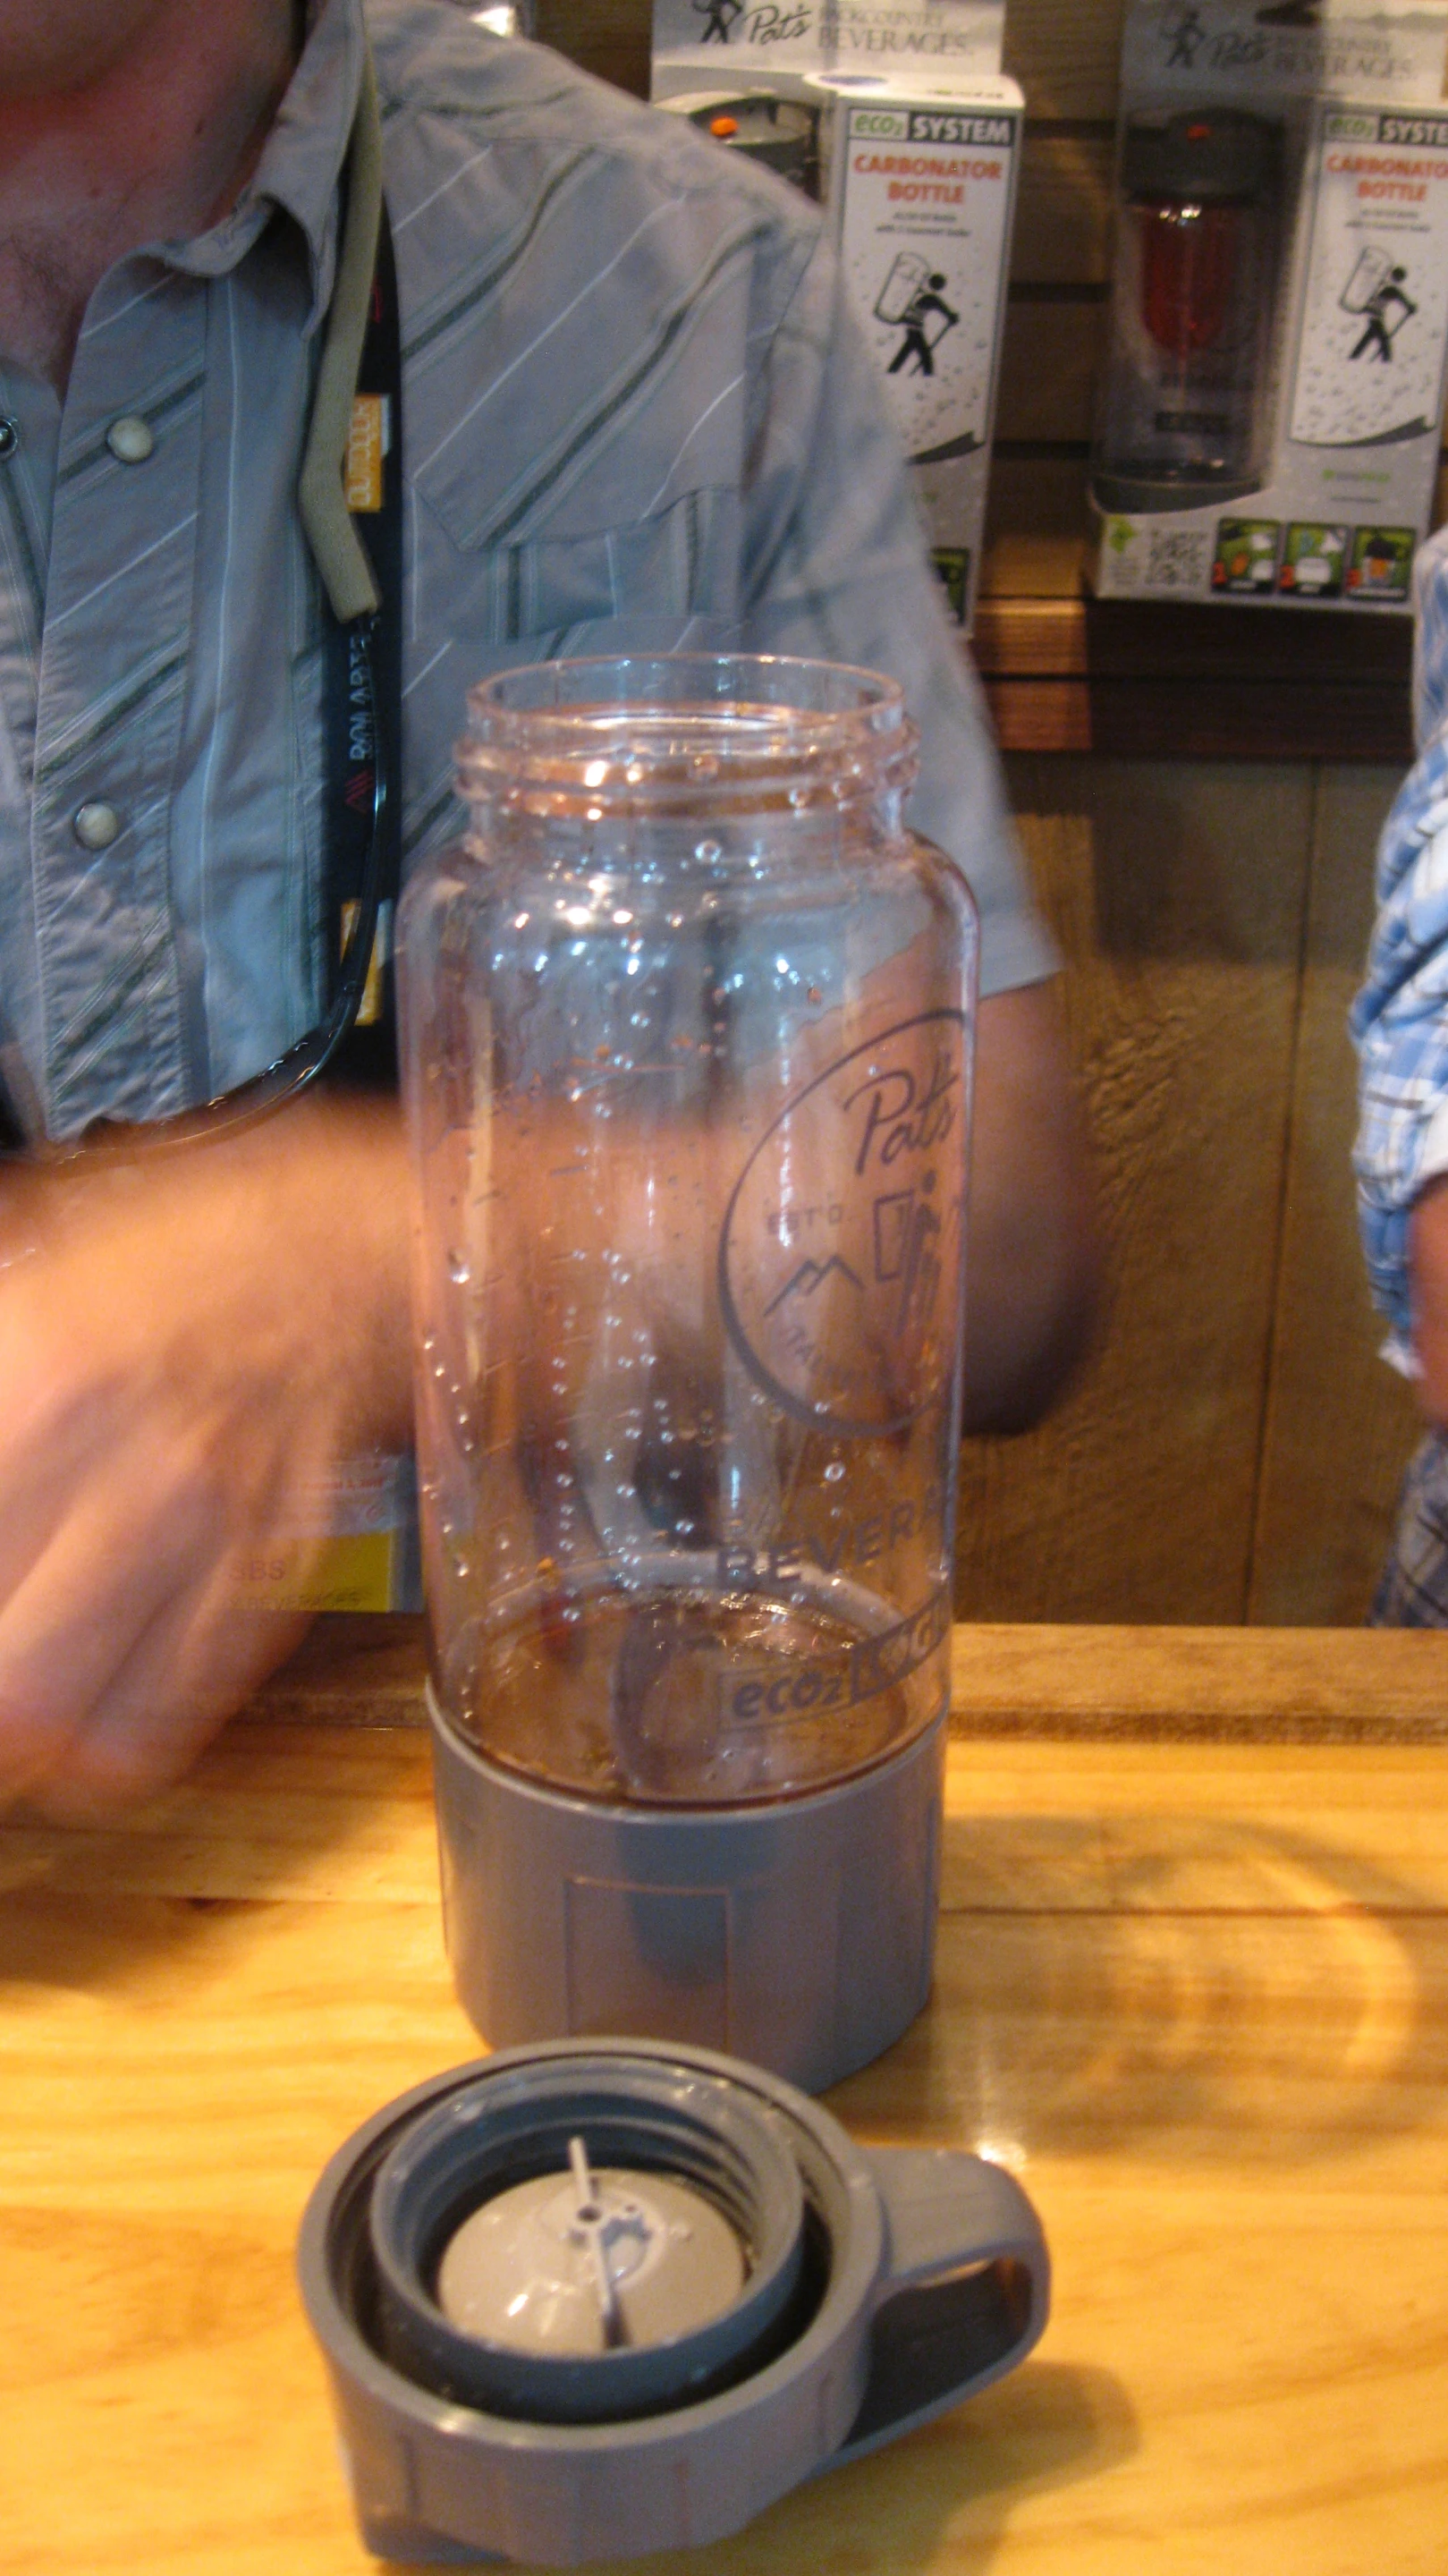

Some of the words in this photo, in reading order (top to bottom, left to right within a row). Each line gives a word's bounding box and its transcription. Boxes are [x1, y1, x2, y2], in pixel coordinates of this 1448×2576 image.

[744, 3, 812, 45] Pat's
[914, 116, 1011, 142] SYSTEM
[1384, 119, 1448, 144] SYSTE
[854, 154, 1003, 180] CARBONATOR
[1326, 153, 1448, 180] CARBONATO
[888, 181, 964, 205] BOTTLE
